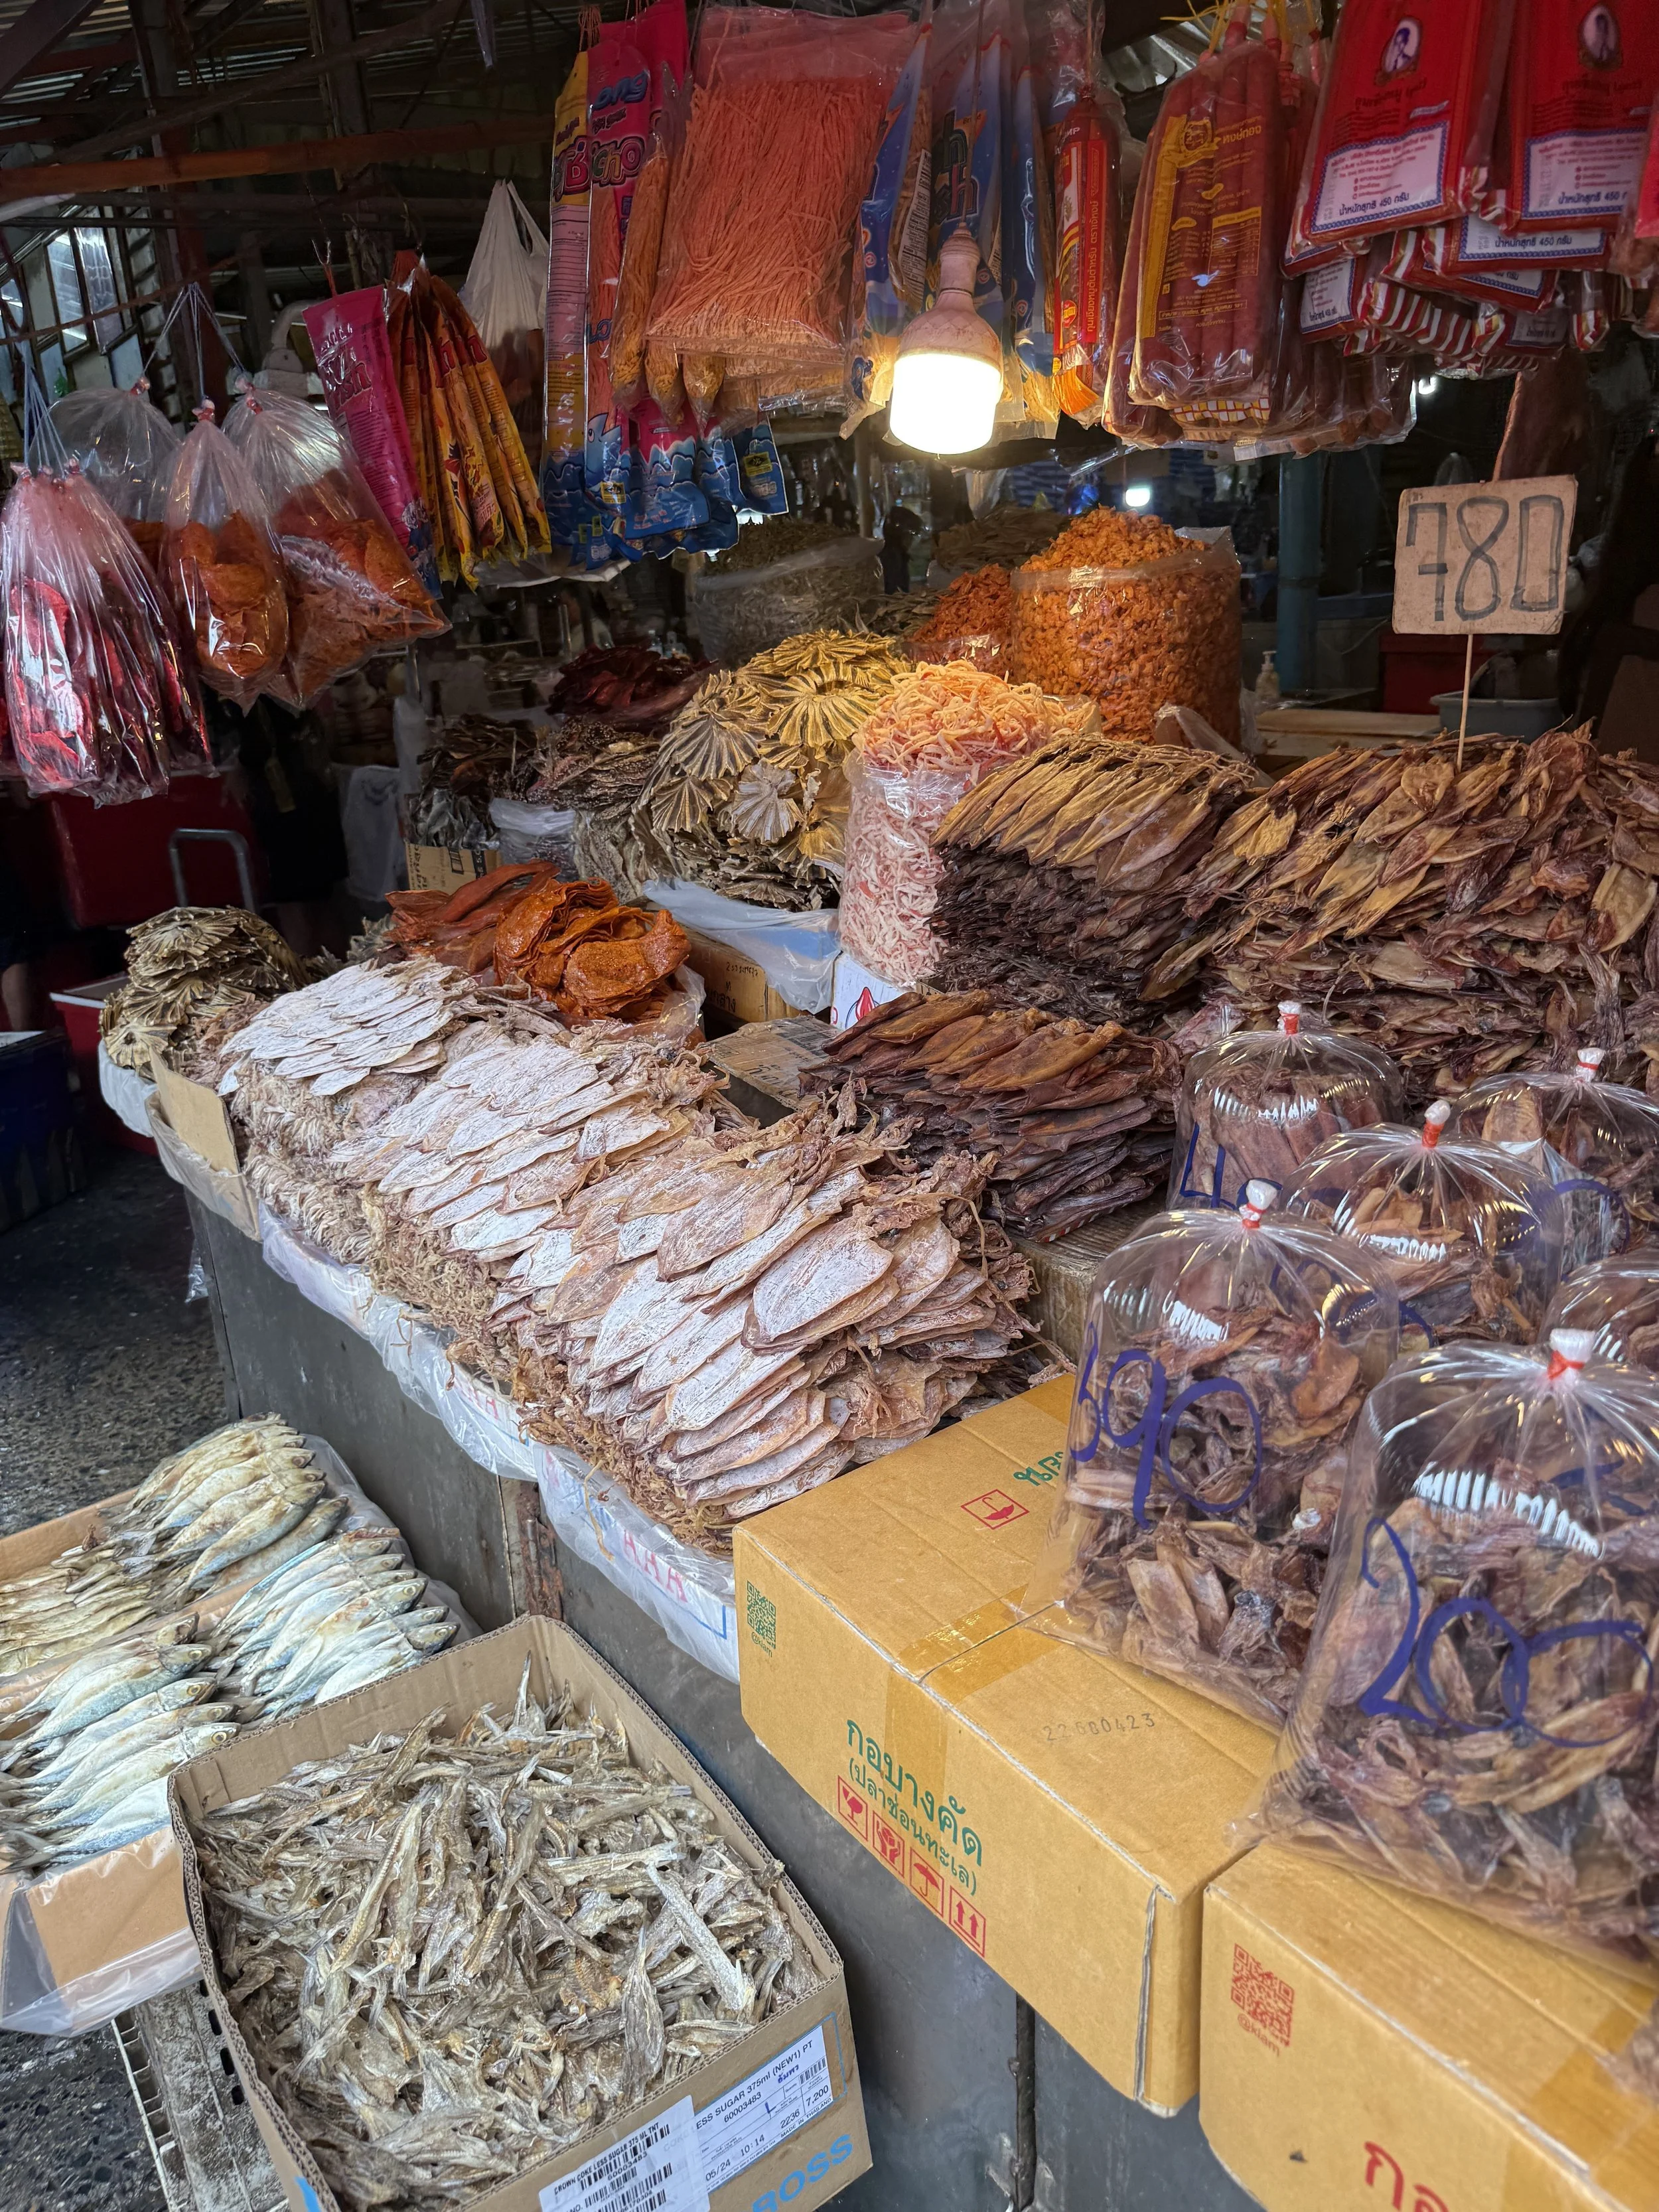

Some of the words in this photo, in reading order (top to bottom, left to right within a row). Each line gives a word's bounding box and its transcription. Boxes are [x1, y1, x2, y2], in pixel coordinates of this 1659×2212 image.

[1495, 235, 1536, 250] น้ำหนักสุทธิ
[1556, 234, 1572, 246] กรัม
[1406, 493, 1565, 623] 780
[1070, 1321, 1261, 1530] 390
[1358, 1516, 1654, 1749] 200
[847, 1719, 982, 1866] กอบางคัด
[849, 1757, 977, 1896] (ปลาช่อนทะเล)
[715, 2090, 745, 2115] SUGAR
[747, 2072, 770, 2094] 375ml
[772, 2049, 801, 2075] (NEW1)
[802, 2040, 813, 2054] PT
[724, 2091, 762, 2123] 60003483
[780, 2124, 797, 2138] MADE
[806, 2097, 833, 2119] THAILAND
[780, 2108, 801, 2129] 2236
[554, 2179, 576, 2195] CROWN
[577, 2167, 593, 2182] COKE
[593, 2158, 608, 2170] LESS
[609, 2145, 628, 2160] SUGAR
[628, 2137, 639, 2148] 375
[639, 2130, 648, 2142] ML
[648, 2122, 660, 2134] TNT
[607, 2151, 648, 2181] 60003483
